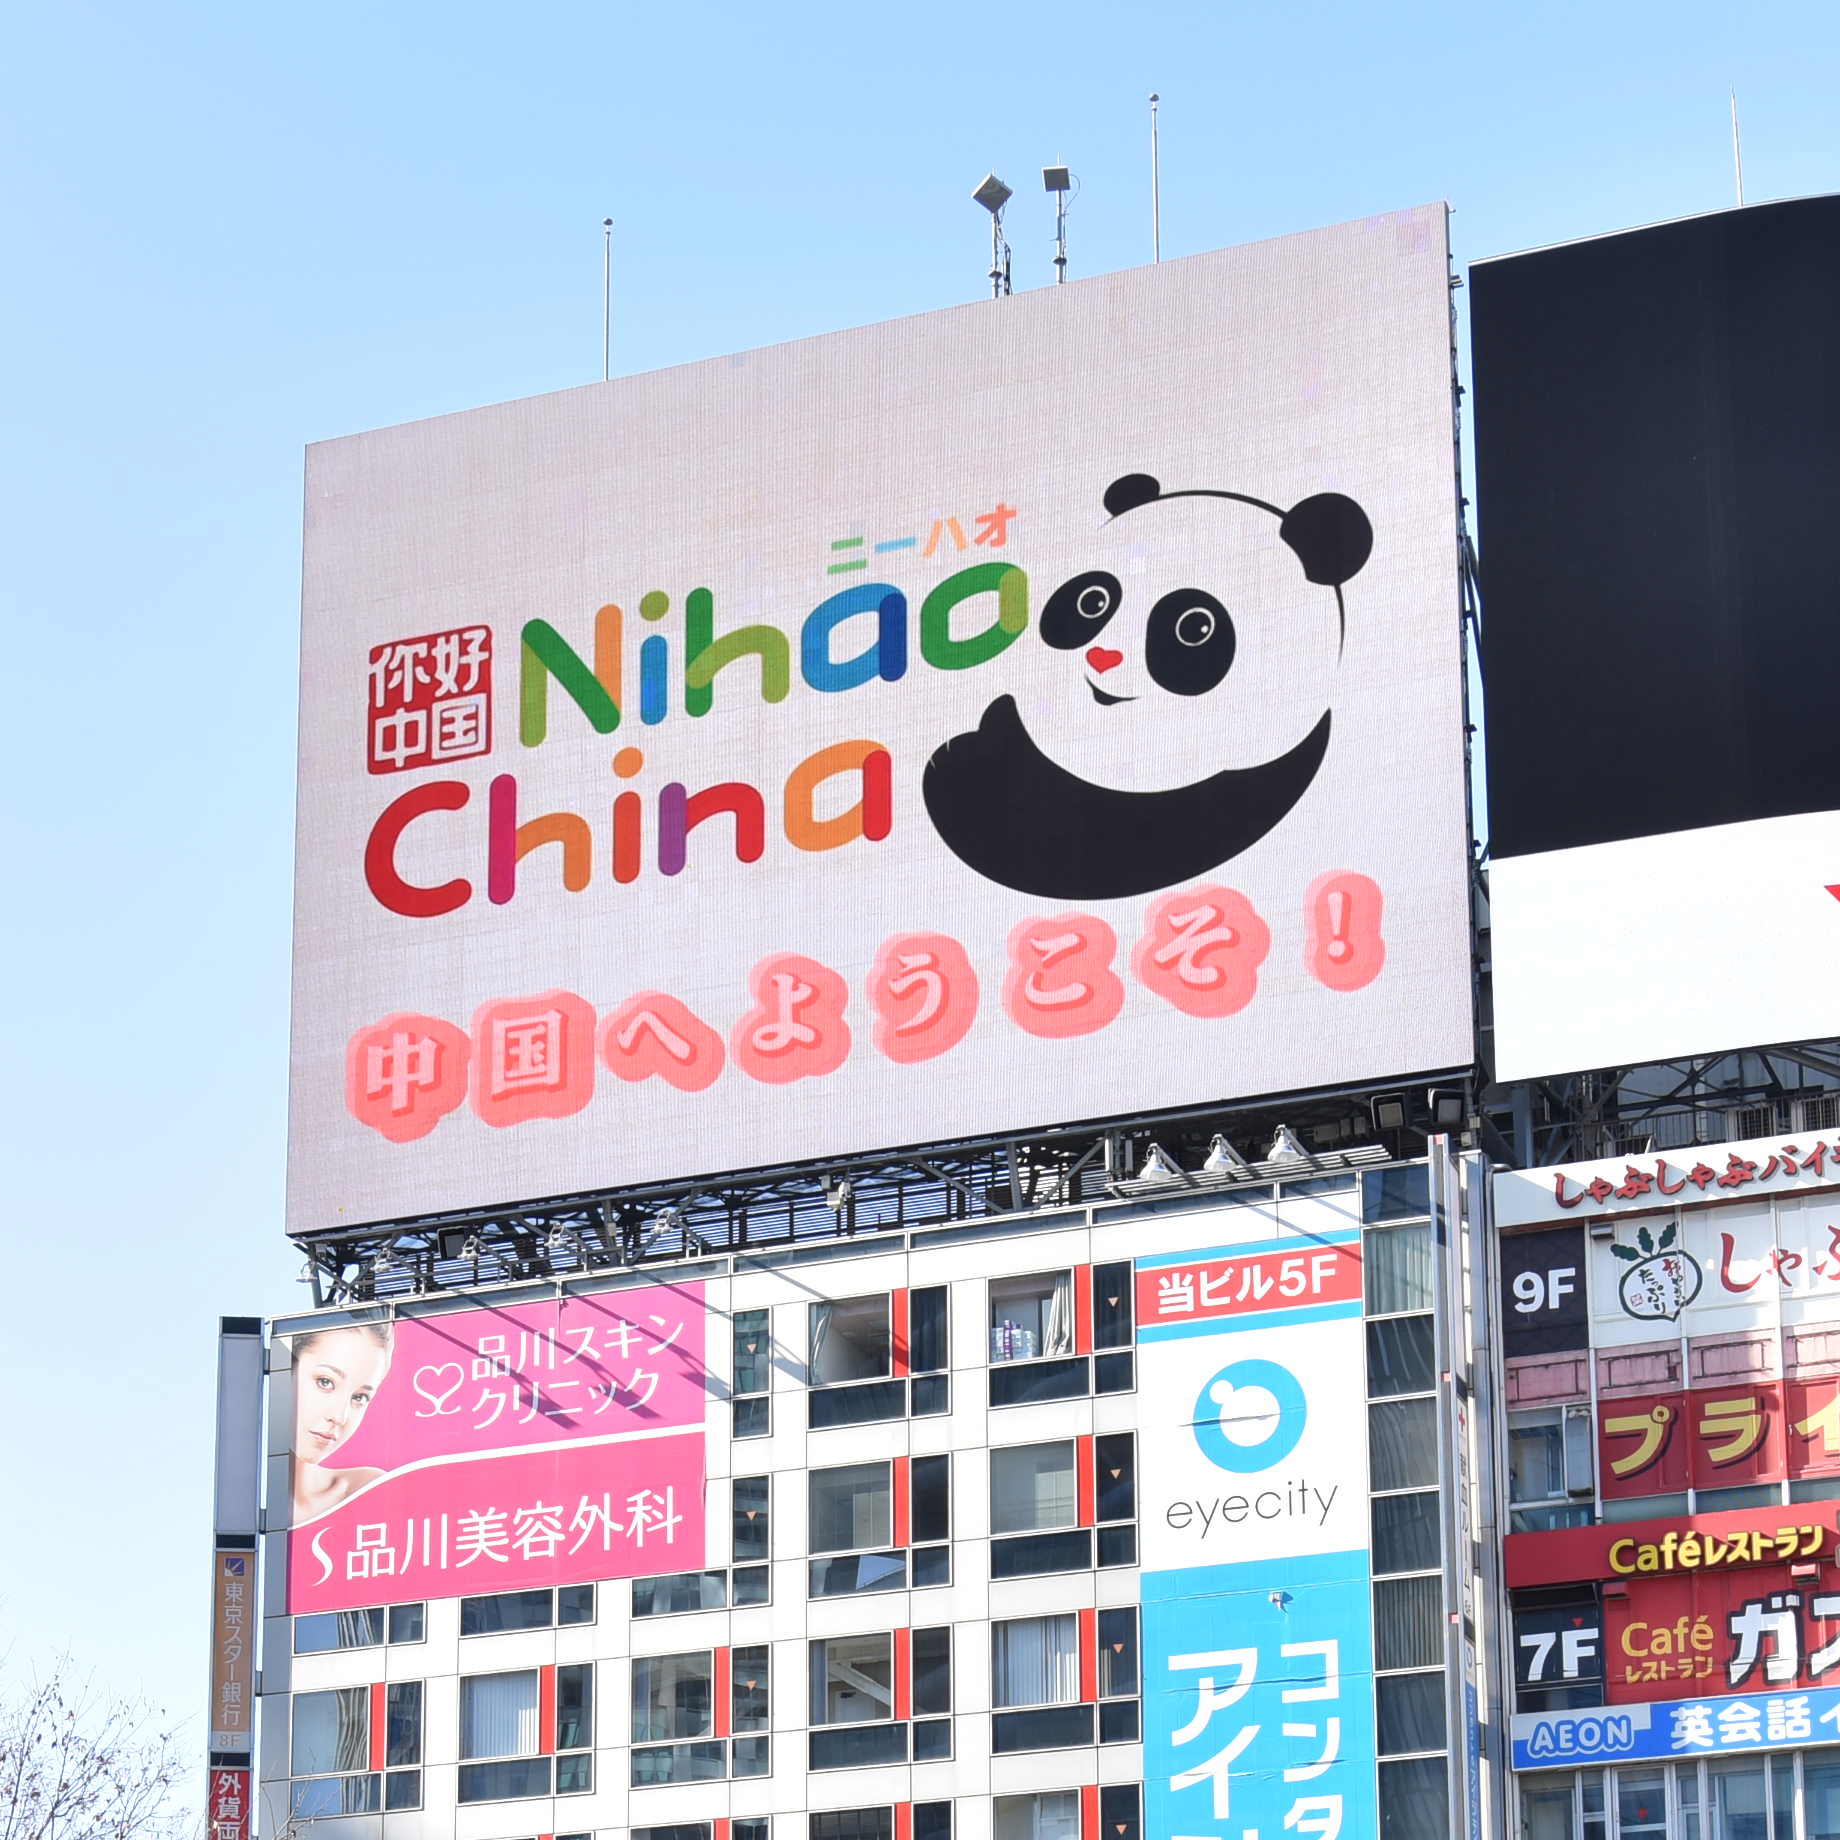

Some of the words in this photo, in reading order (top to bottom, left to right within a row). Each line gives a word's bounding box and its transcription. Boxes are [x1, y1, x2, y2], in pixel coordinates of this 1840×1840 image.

[826, 502, 1018, 576] ニーハオ
[368, 628, 491, 710] 你好
[517, 560, 1030, 750] Nihao
[371, 704, 490, 770] 中国
[363, 738, 893, 918] China
[358, 885, 1365, 1118] 中国へようこそ！
[1156, 1254, 1339, 1316] 当ビル5F
[1512, 1266, 1577, 1315] 9F
[470, 1313, 685, 1380] 品川スキン
[470, 1368, 661, 1431] クリニック
[345, 1486, 684, 1582] 品川美容外科
[1165, 1478, 1339, 1540] eyecity
[221, 1582, 245, 1726] 東京スター銀行
[1519, 1625, 1600, 1682] 7F
[1621, 1614, 1715, 1659] Café
[1625, 1655, 1714, 1684] レストラン
[219, 1734, 242, 1748] 8F
[1528, 1716, 1634, 1757] AEON
